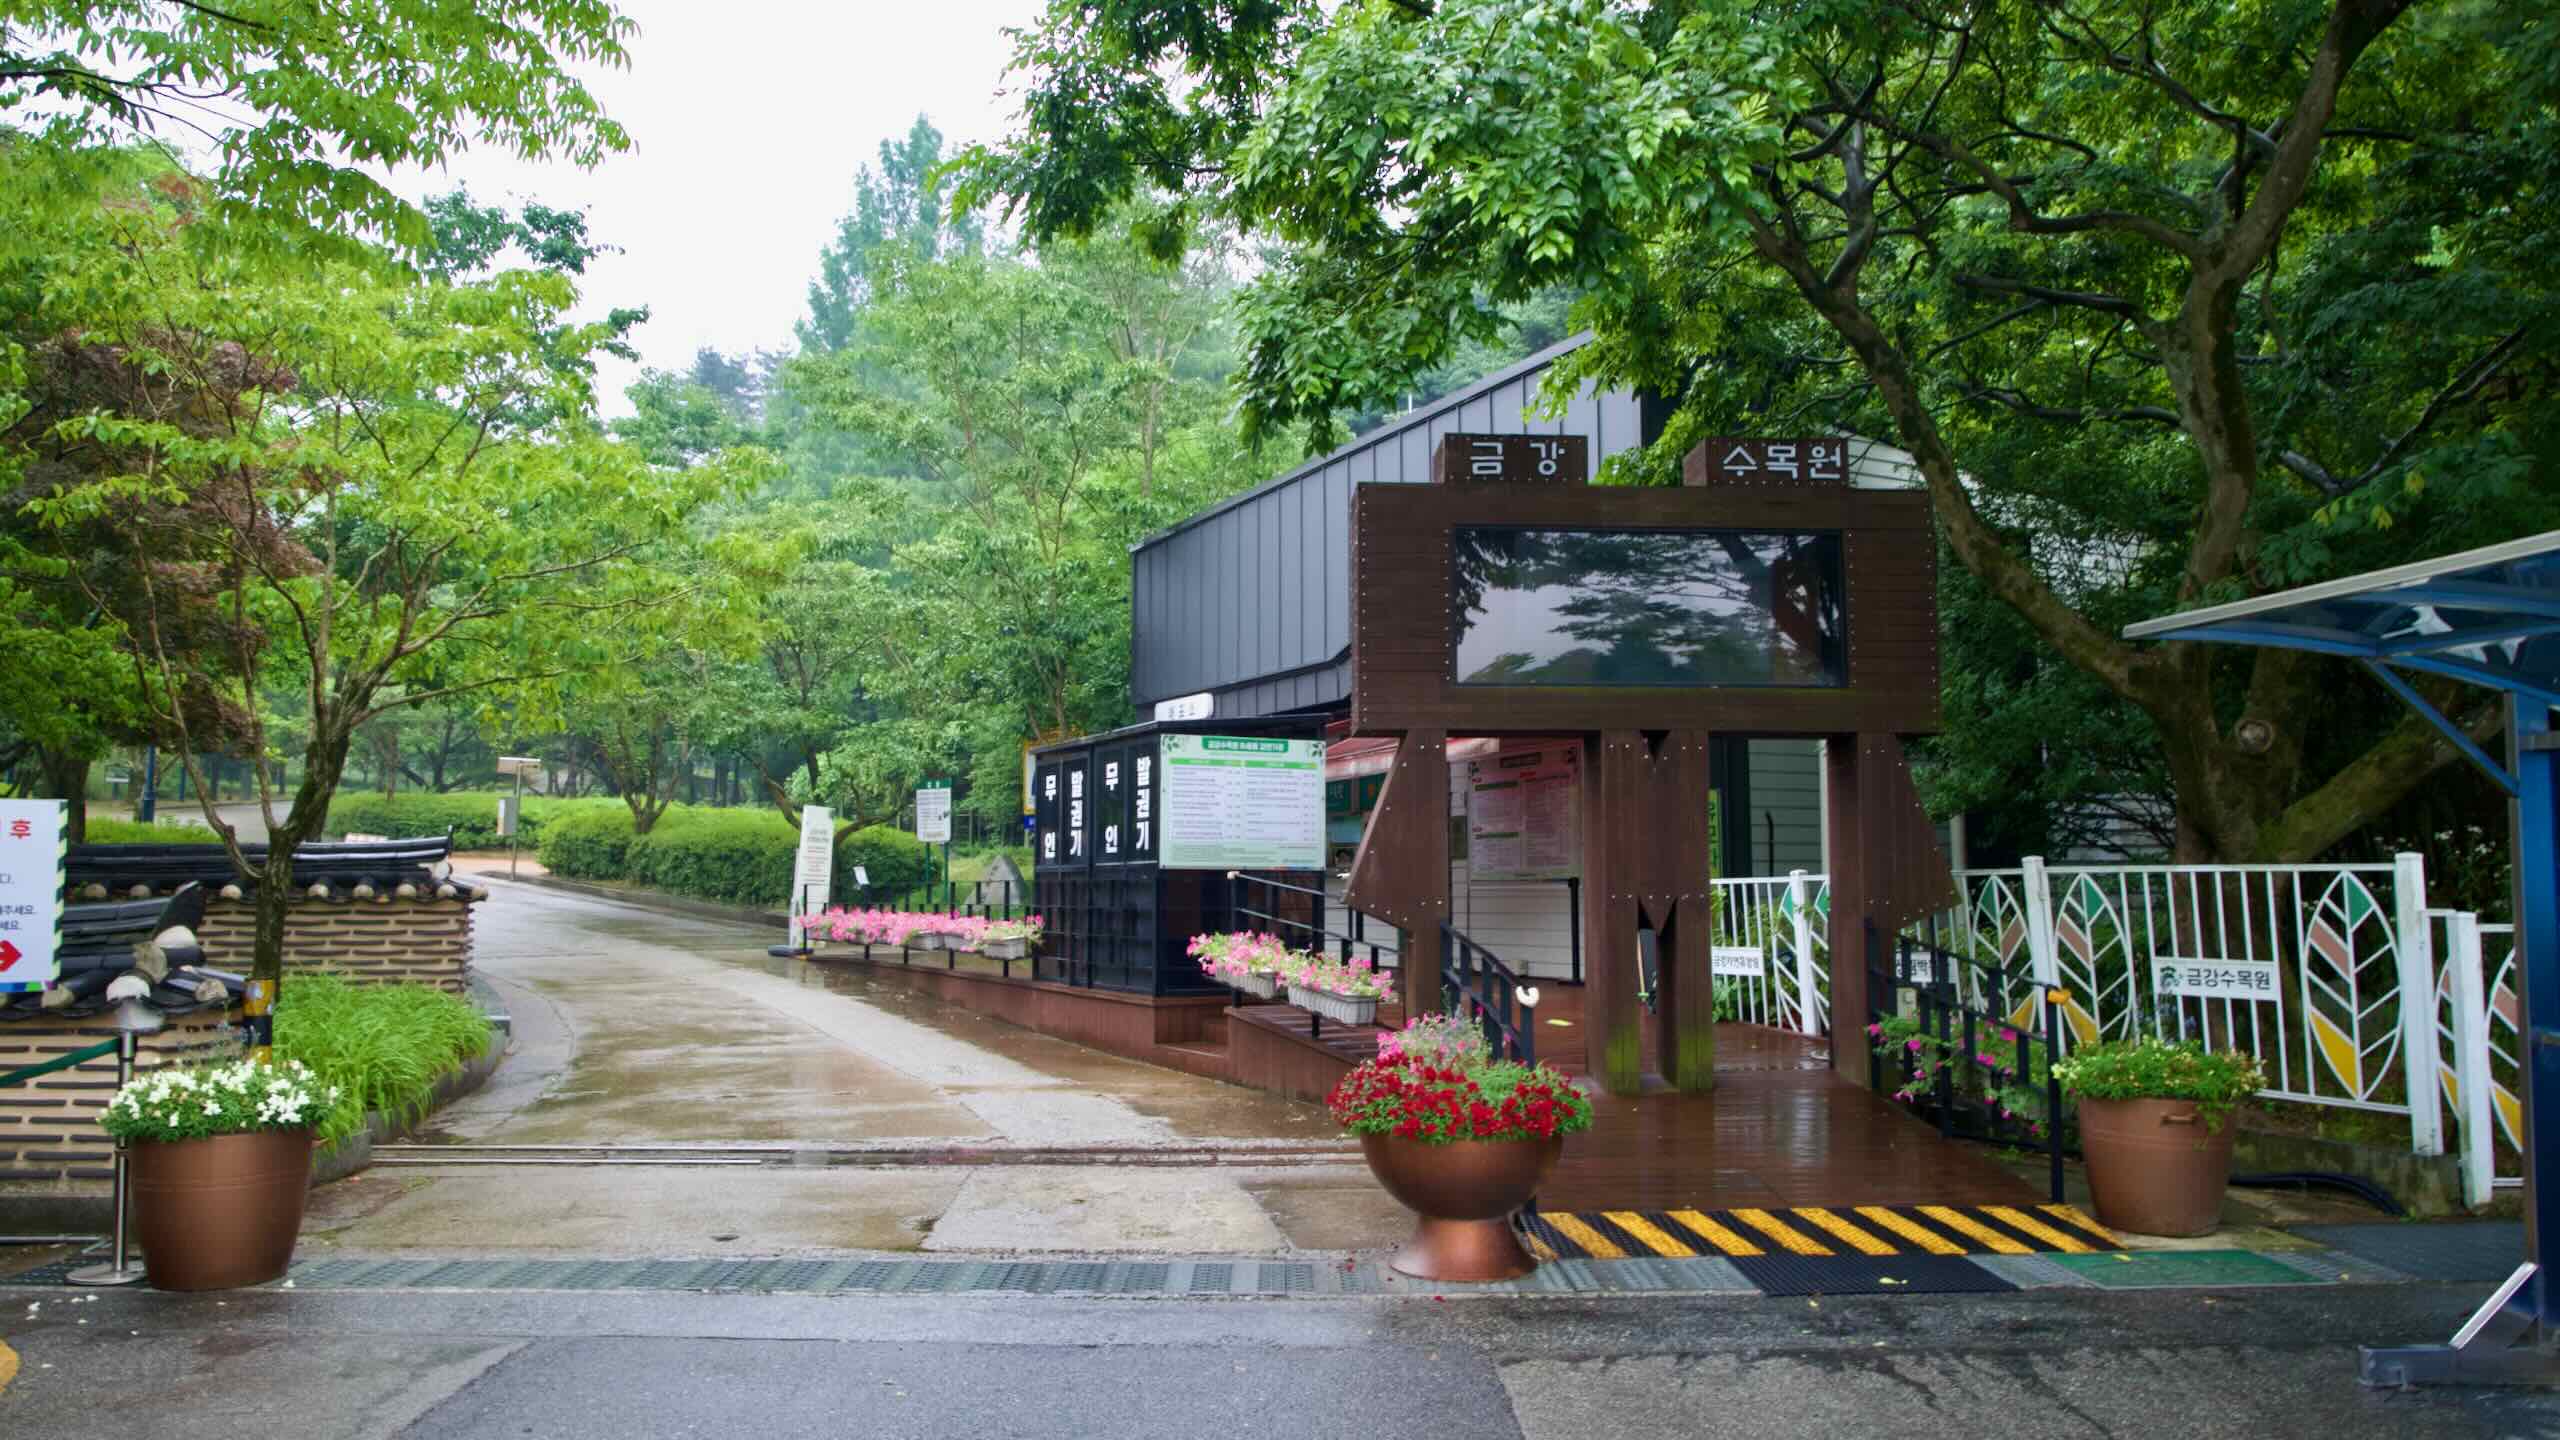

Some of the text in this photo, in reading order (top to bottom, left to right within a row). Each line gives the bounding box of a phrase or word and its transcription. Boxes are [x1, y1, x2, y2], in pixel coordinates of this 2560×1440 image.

[1722, 443, 1842, 480] 수목원
[1069, 770, 1083, 856] 발권기
[1136, 756, 1151, 850] 발권기
[9, 819, 32, 840] 후
[0, 903, 36, 915] 주세요.
[2187, 967, 2271, 990] 금강수목원
